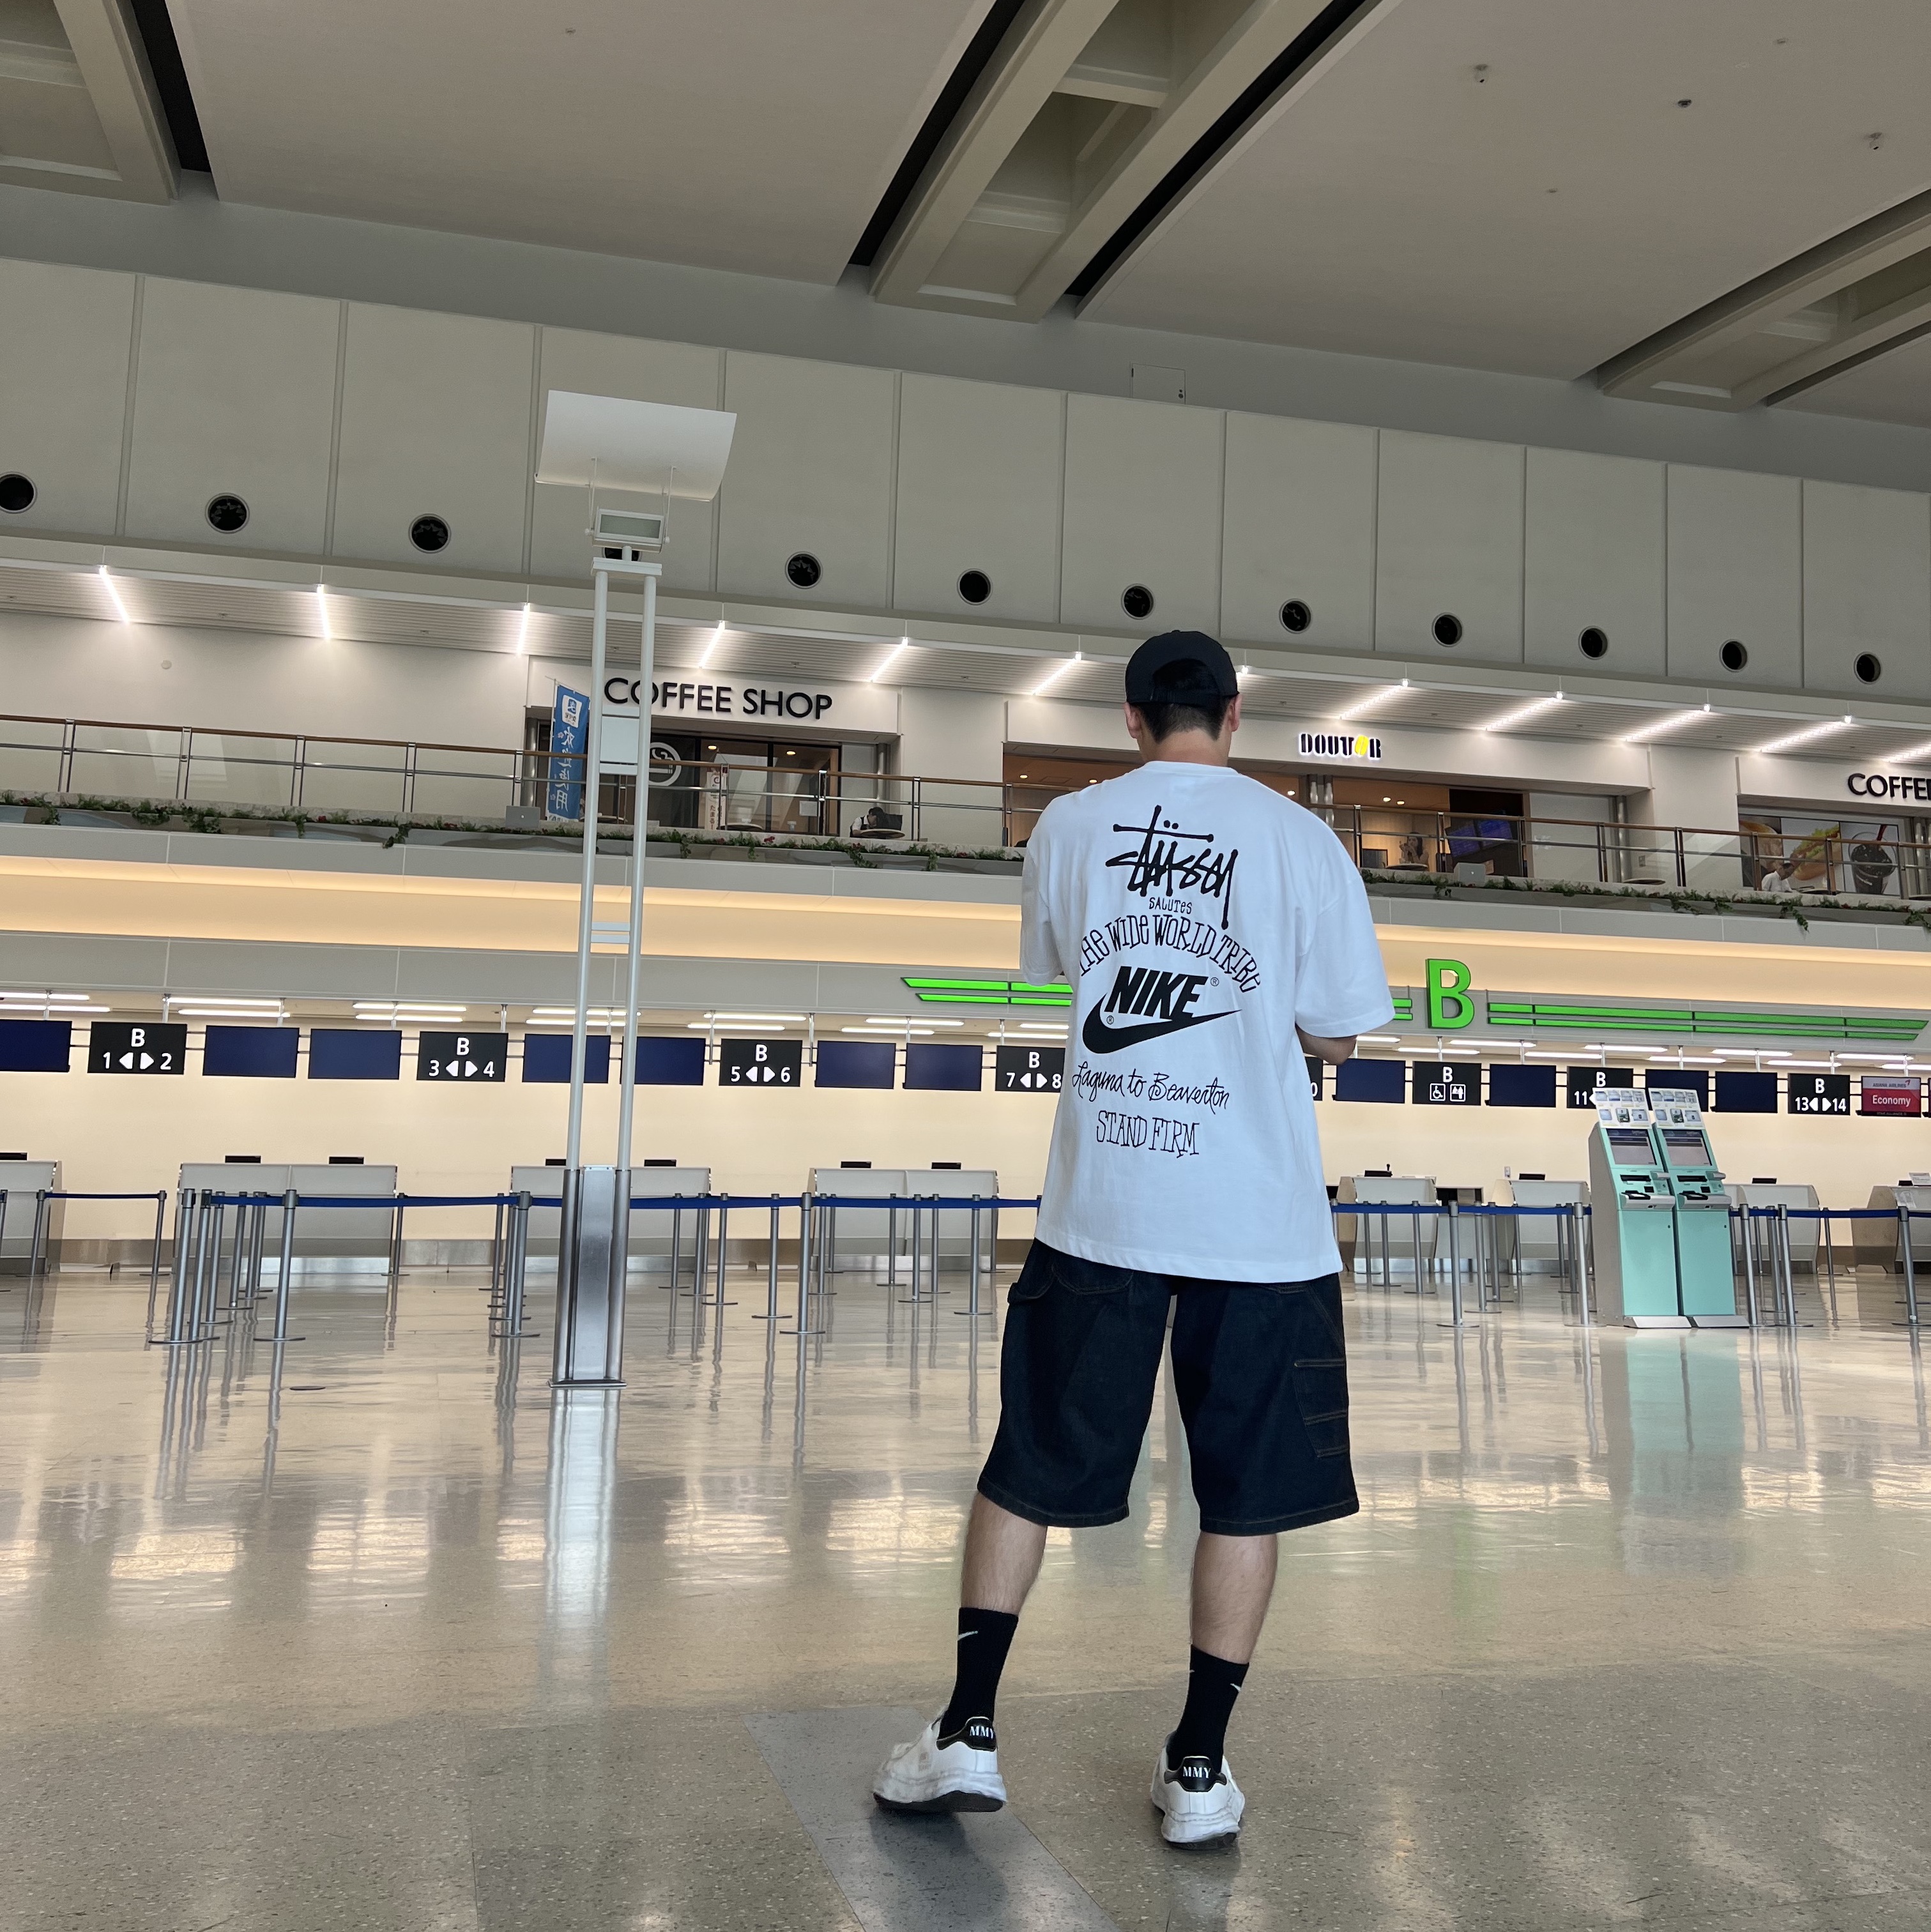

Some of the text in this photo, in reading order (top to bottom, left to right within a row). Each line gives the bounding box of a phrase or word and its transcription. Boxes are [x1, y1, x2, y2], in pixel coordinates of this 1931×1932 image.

[604, 677, 832, 719] COFFEE SHOP
[1299, 733, 1382, 759] DOUTOR
[1152, 914, 1217, 958] WORLD
[1104, 966, 1209, 1019] NIKE
[1425, 959, 1475, 1029] B
[131, 1028, 146, 1047] B
[457, 1037, 469, 1056] B
[755, 1044, 768, 1061] B
[103, 1051, 172, 1070] 1 2
[429, 1060, 494, 1077] 3 4
[1028, 1051, 1040, 1069] B
[731, 1066, 791, 1083] 5 6
[1006, 1072, 1062, 1089] 7 8
[1442, 1066, 1453, 1083] B
[1596, 1071, 1607, 1087] B
[1072, 1061, 1230, 1114] Laguna to Beaverton
[1310, 1082, 1318, 1097] 0
[1815, 1078, 1825, 1093] B
[1574, 1090, 1588, 1106] 11
[1795, 1097, 1847, 1112] 13 14
[1872, 1094, 1911, 1107] Economy
[1096, 1110, 1200, 1158] STAND FIRM
[1182, 1766, 1212, 1779] MMY
